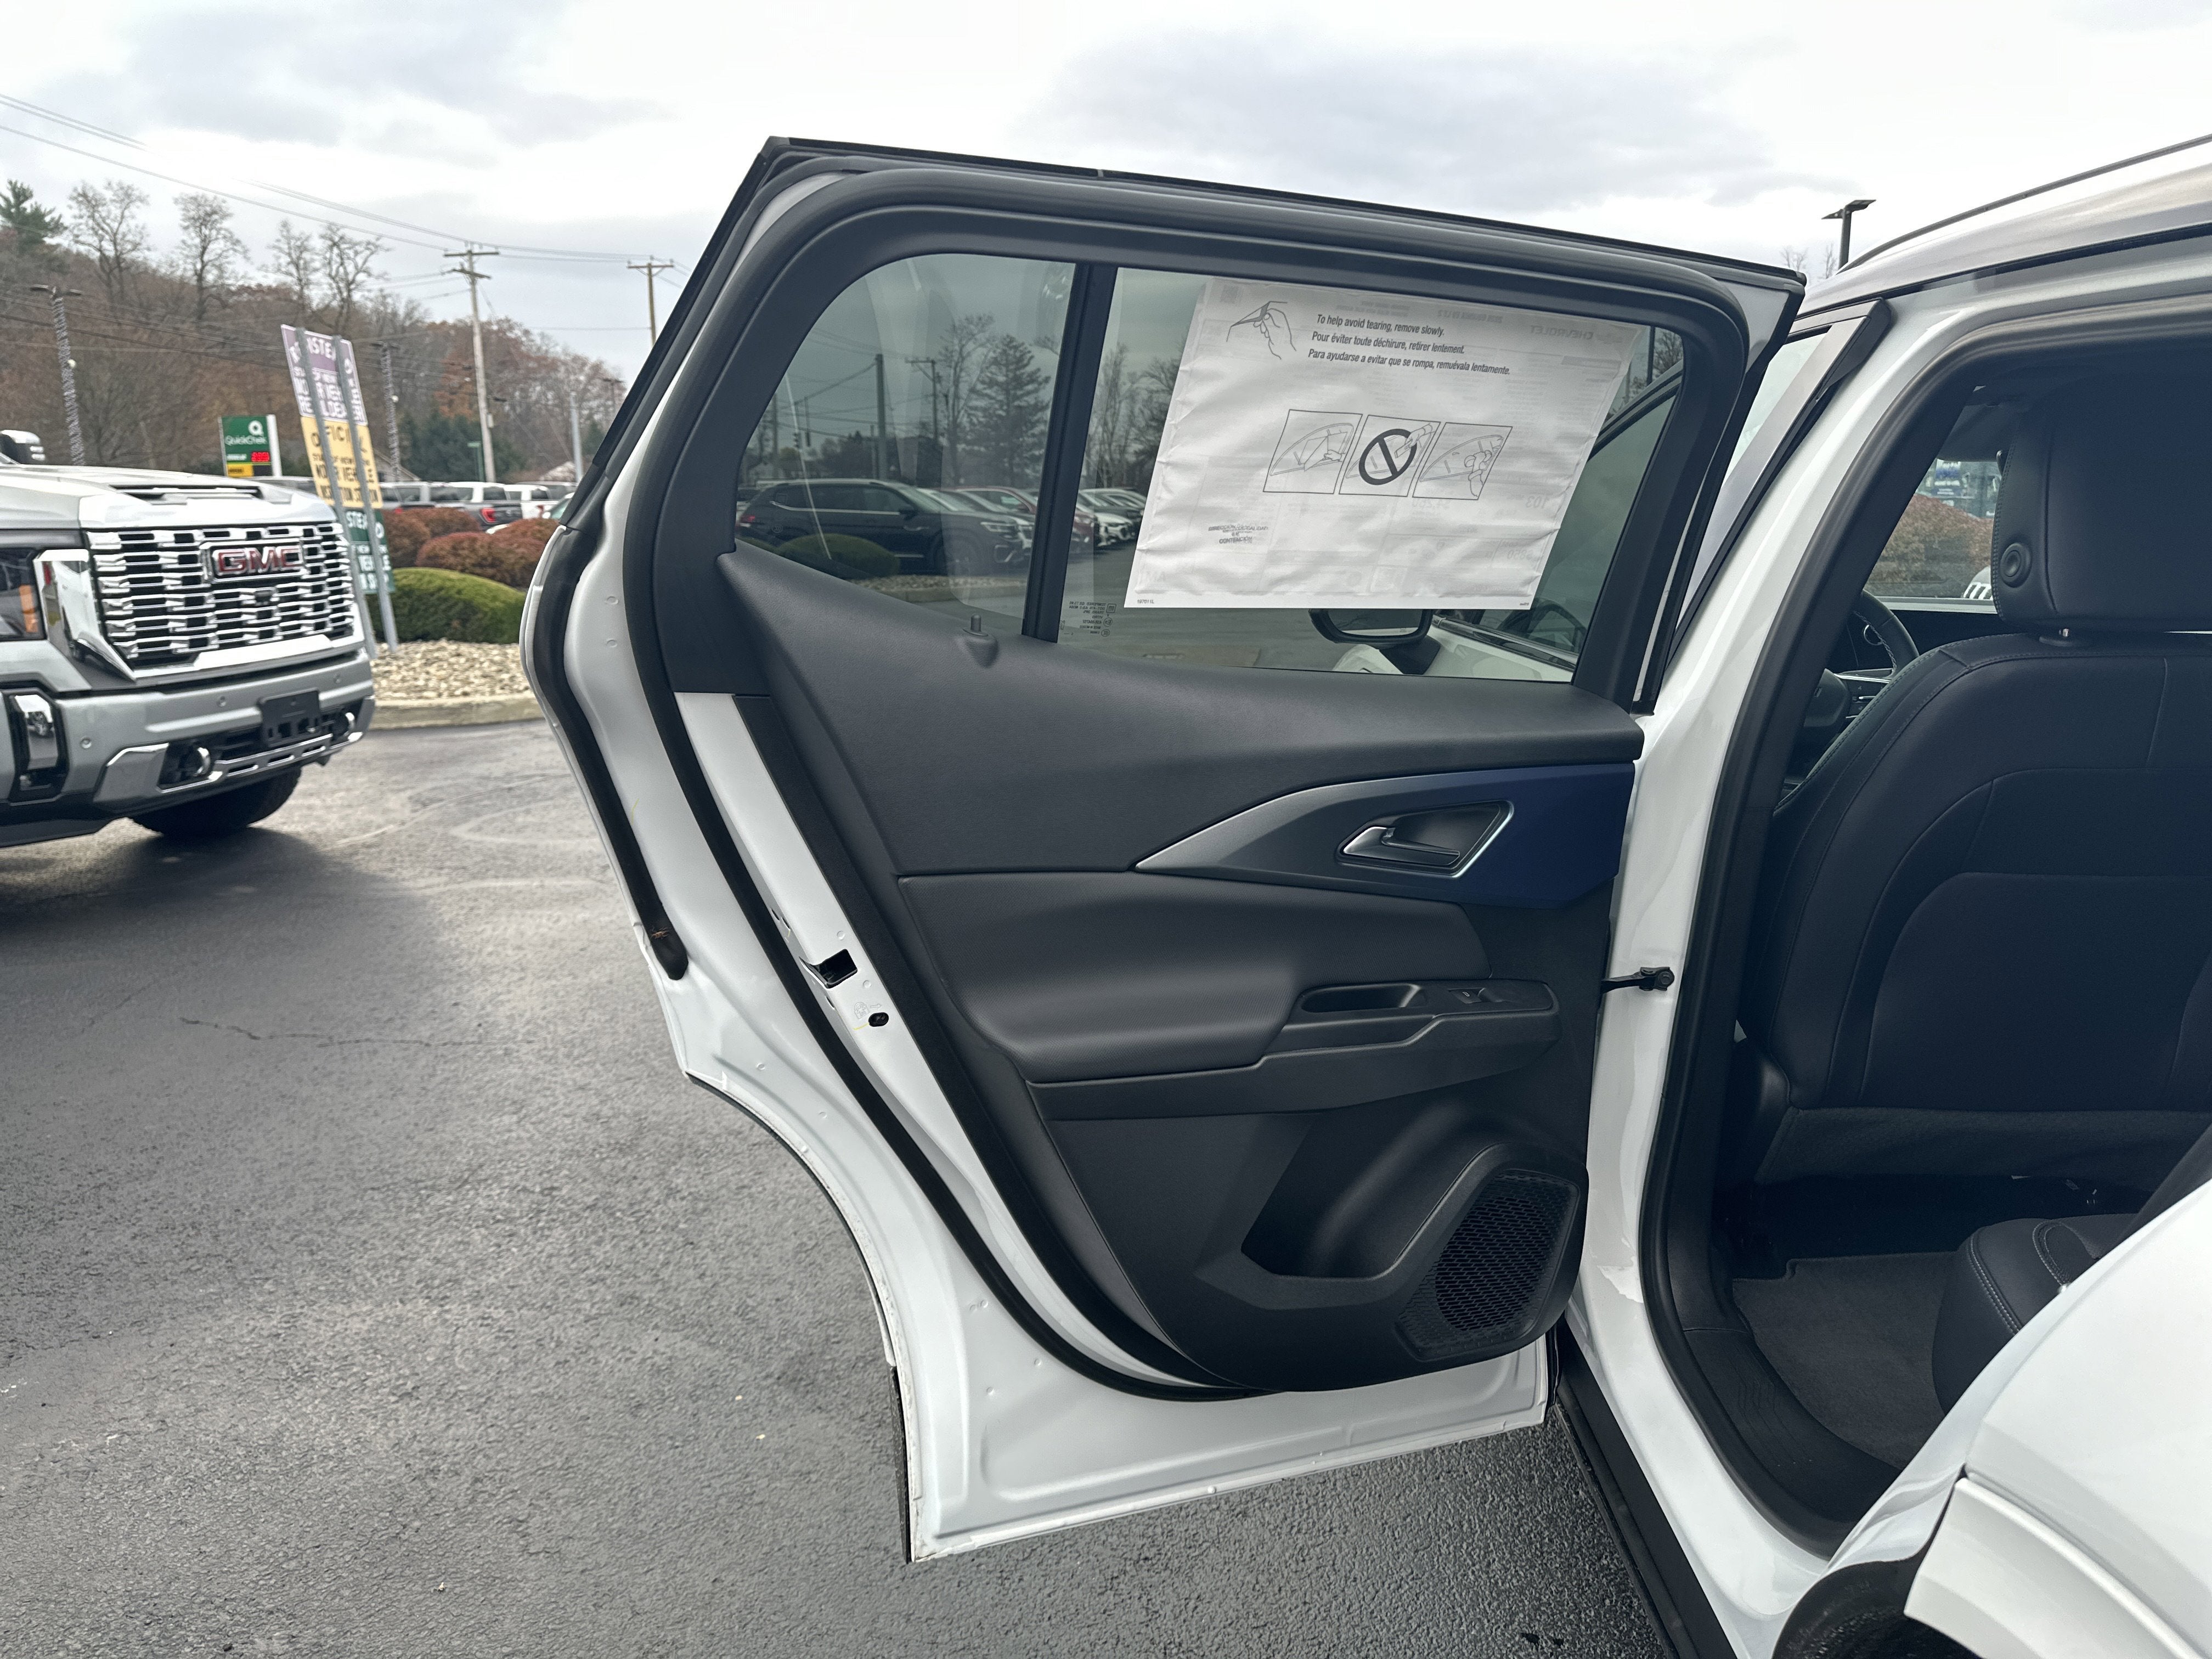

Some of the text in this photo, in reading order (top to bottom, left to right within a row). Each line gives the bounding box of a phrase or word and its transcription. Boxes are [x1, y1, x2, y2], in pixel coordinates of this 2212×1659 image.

[1317, 314, 1444, 337] To help avoid tearing, remove slowly.
[1312, 331, 1329, 342] Pour
[1331, 332, 1352, 344] éviter
[1354, 336, 1372, 346] toute
[1373, 337, 1407, 350] déchirure,
[1409, 341, 1431, 352] retirer
[1308, 348, 1325, 359] Para
[1327, 352, 1359, 362] ayudarse
[1367, 355, 1387, 364] evitar
[1389, 358, 1401, 366] que
[1412, 359, 1435, 370] rompa,
[1436, 360, 1470, 371] remuévala
[1471, 363, 1510, 375] lentamente.
[212, 545, 302, 575] GMC
